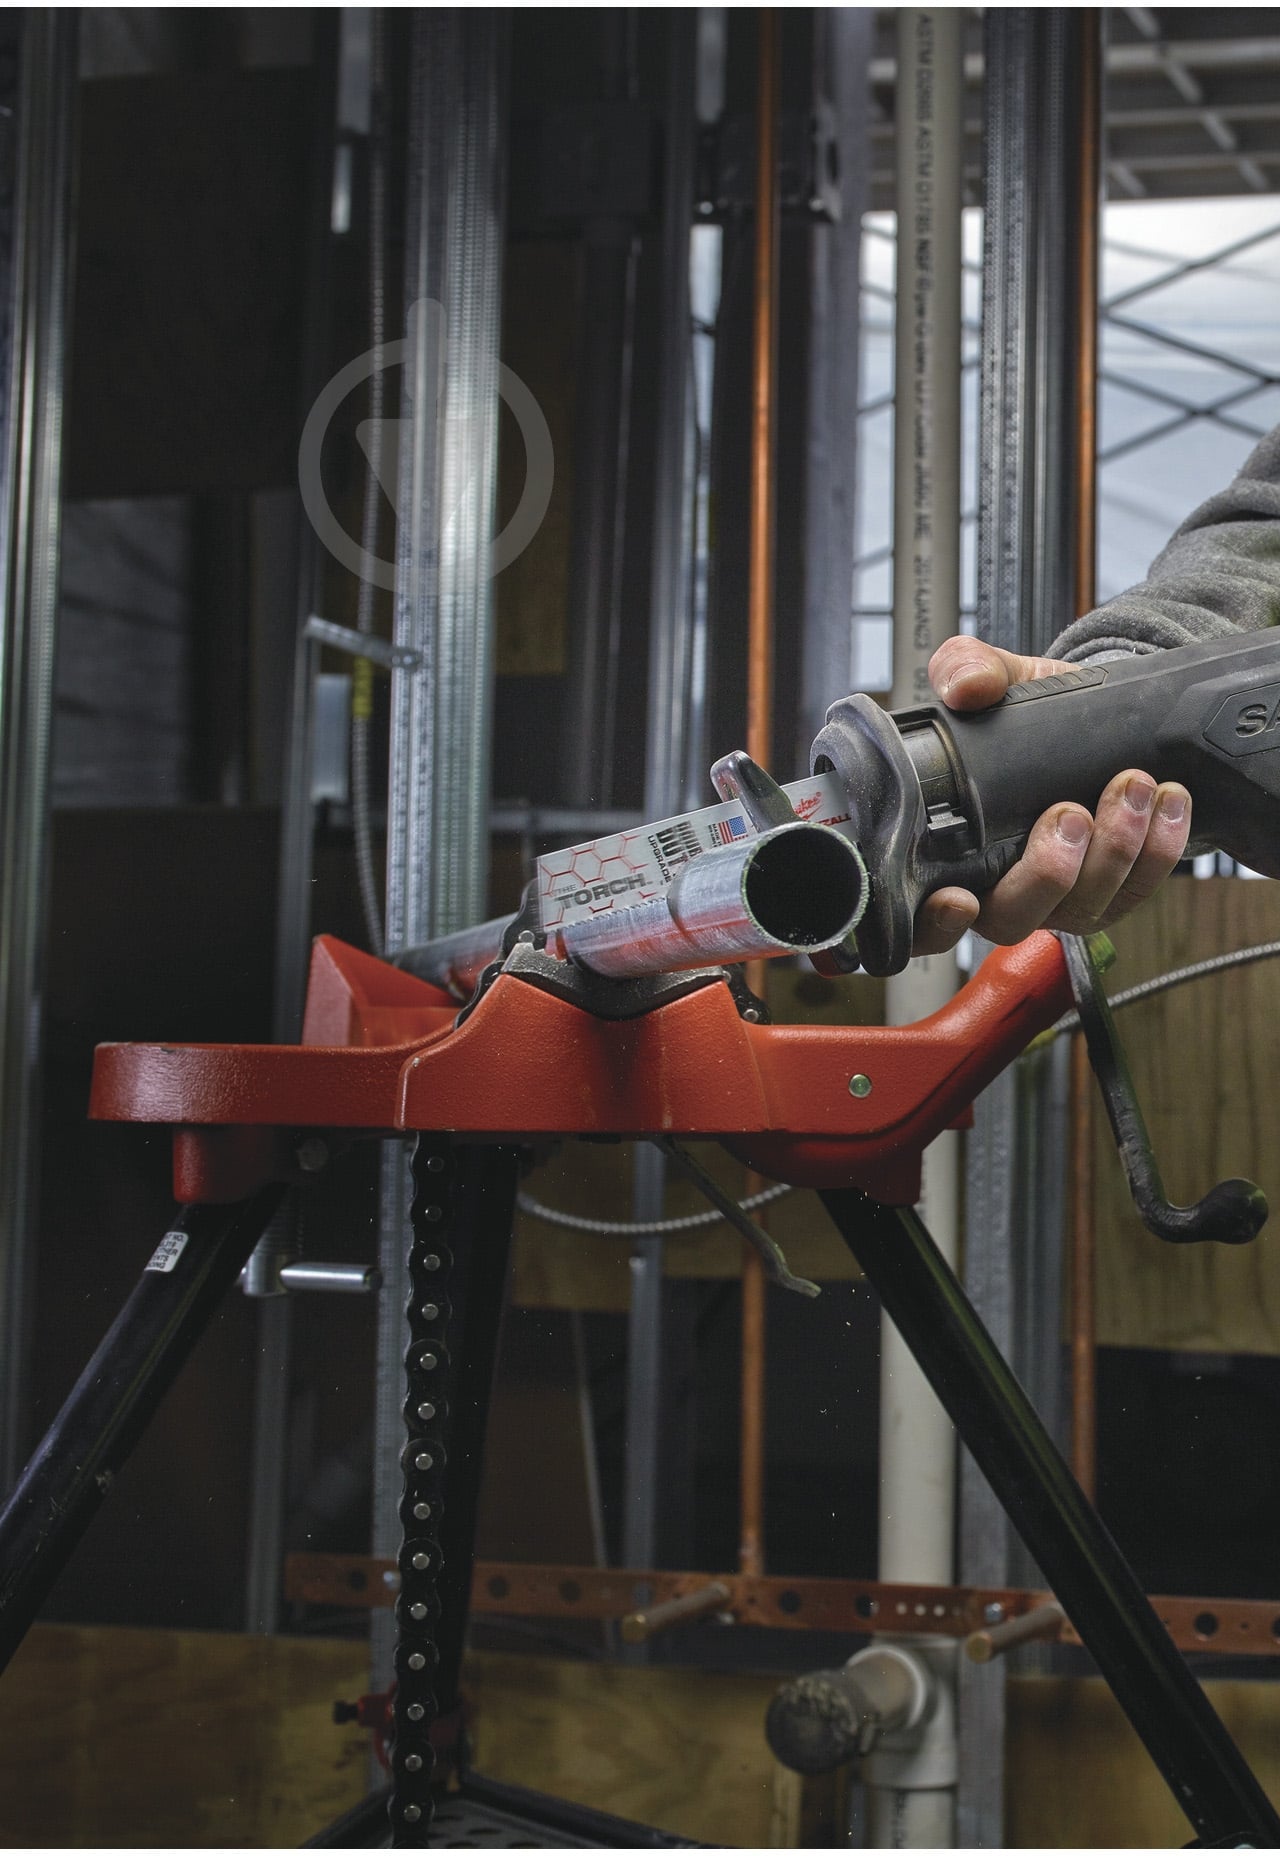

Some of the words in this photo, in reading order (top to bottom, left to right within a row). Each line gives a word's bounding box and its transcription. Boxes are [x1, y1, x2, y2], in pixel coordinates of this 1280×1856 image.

[648, 835, 673, 883] UPGRADE
[656, 827, 689, 867] DUT
[553, 884, 577, 895] THE
[554, 873, 647, 909] TORCH
